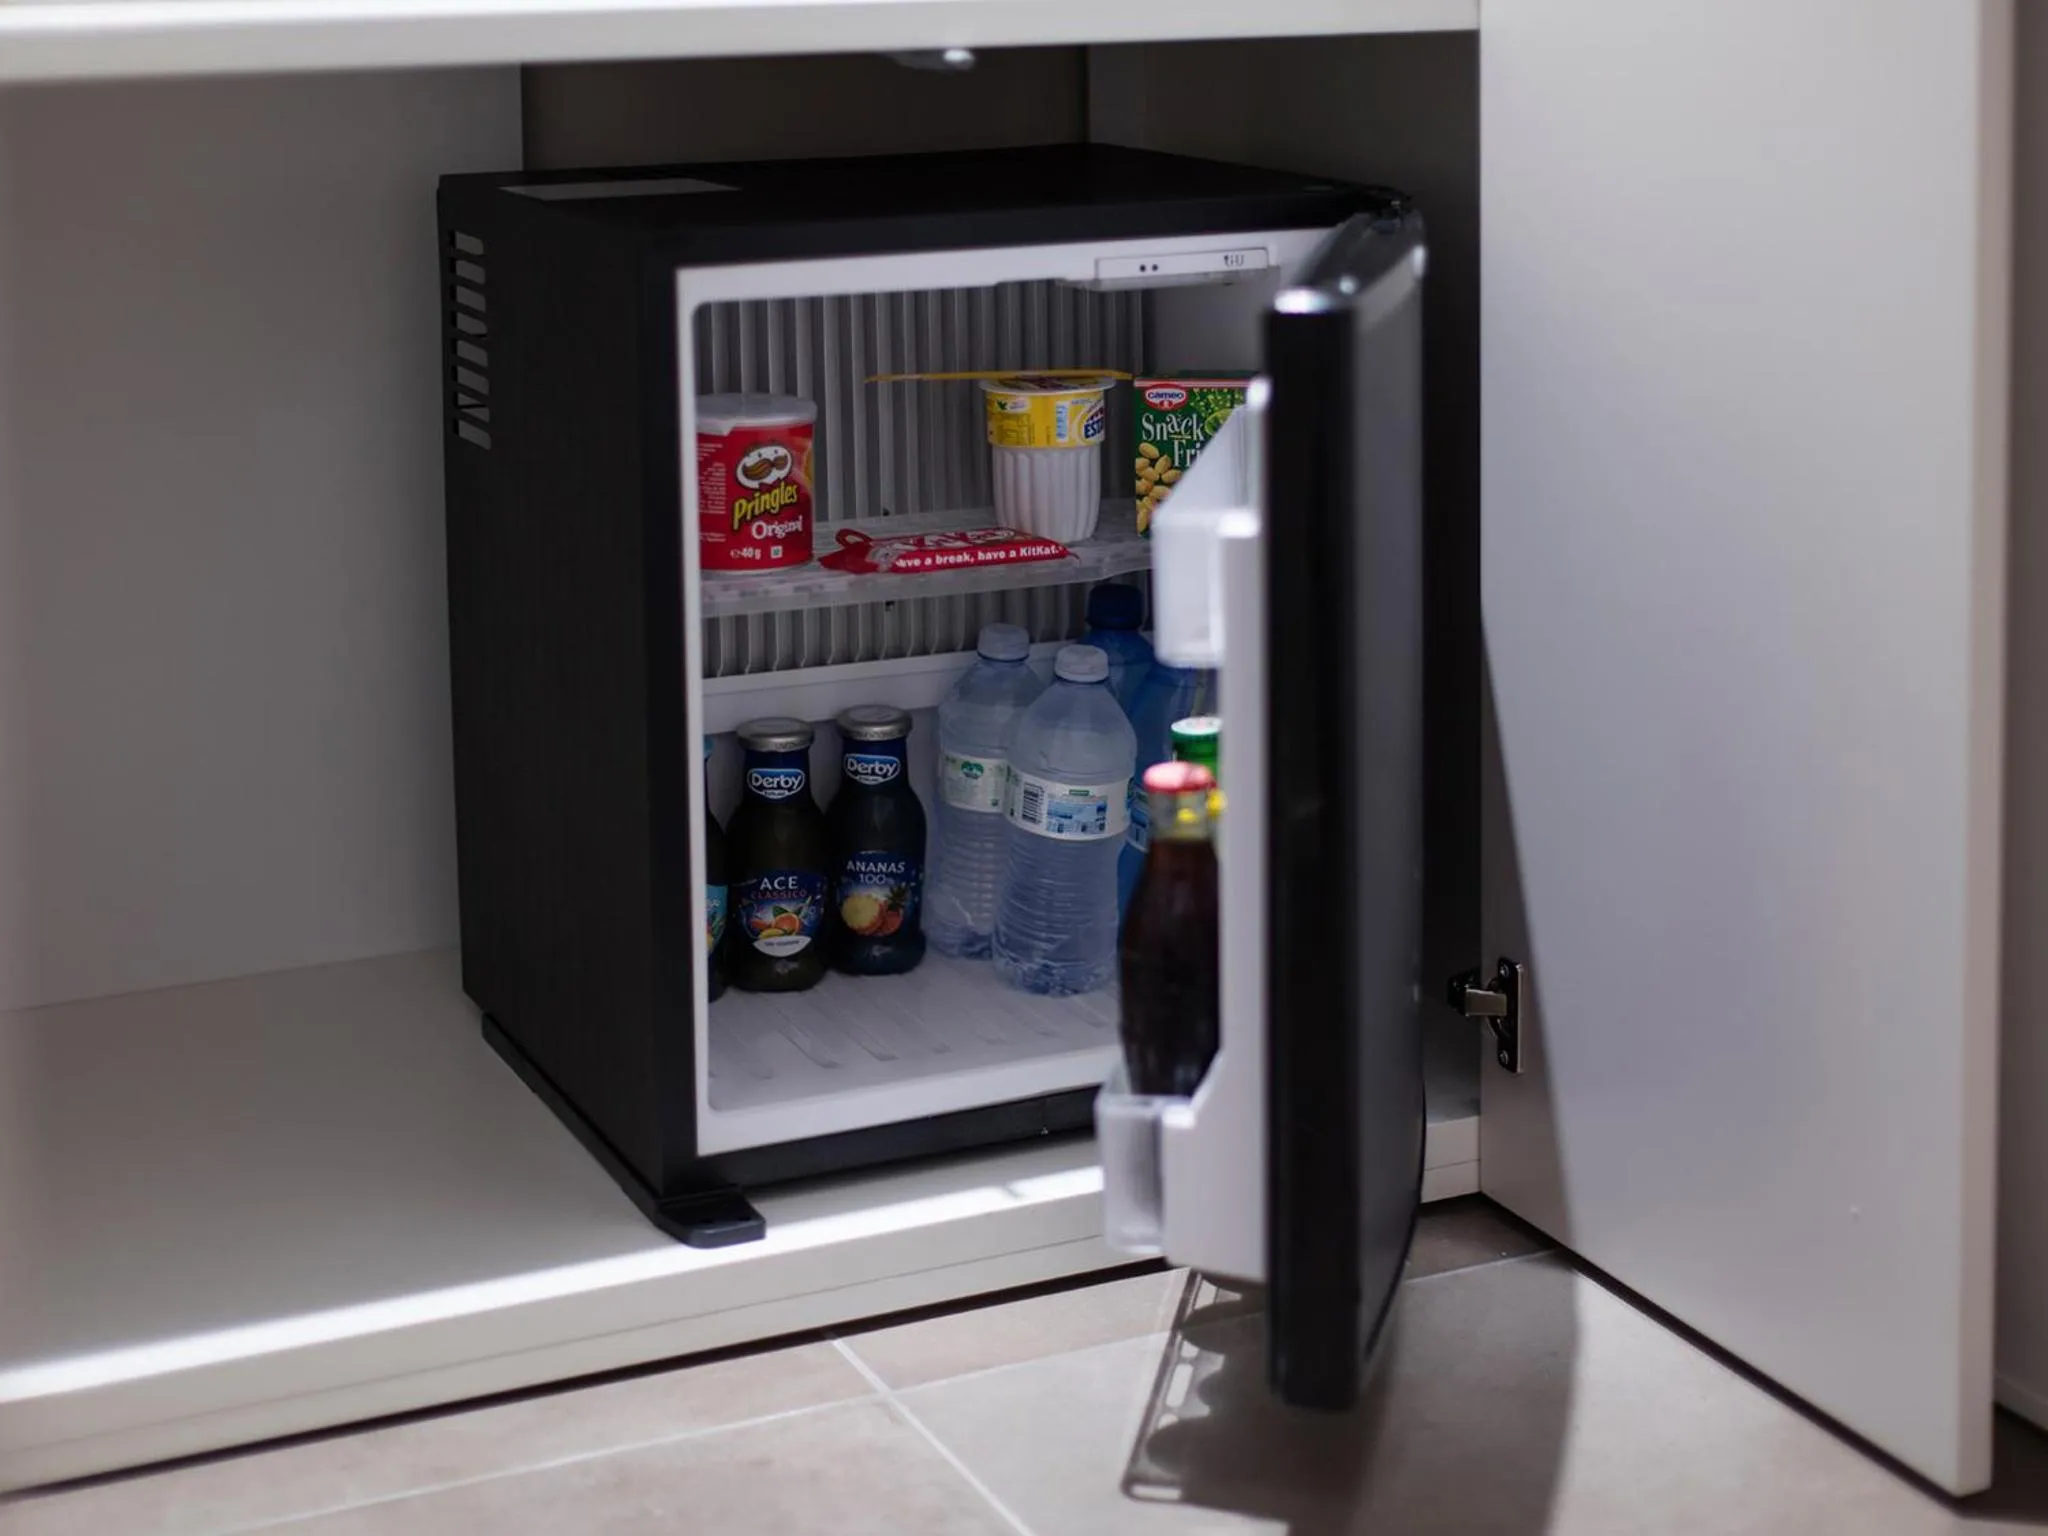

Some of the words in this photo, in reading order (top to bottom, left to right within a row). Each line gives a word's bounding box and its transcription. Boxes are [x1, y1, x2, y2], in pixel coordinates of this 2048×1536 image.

[1141, 412, 1205, 441] Snack
[732, 481, 798, 532] Pringles
[751, 515, 803, 540] Original
[924, 557, 932, 566] a
[935, 552, 975, 565] break,
[978, 551, 1006, 561] have
[1009, 550, 1017, 558] a
[847, 757, 897, 776] Derby
[751, 773, 802, 790] Derby
[846, 859, 906, 874] ANANAS
[760, 875, 799, 891] ACE
[750, 889, 808, 900] CLASSICO
